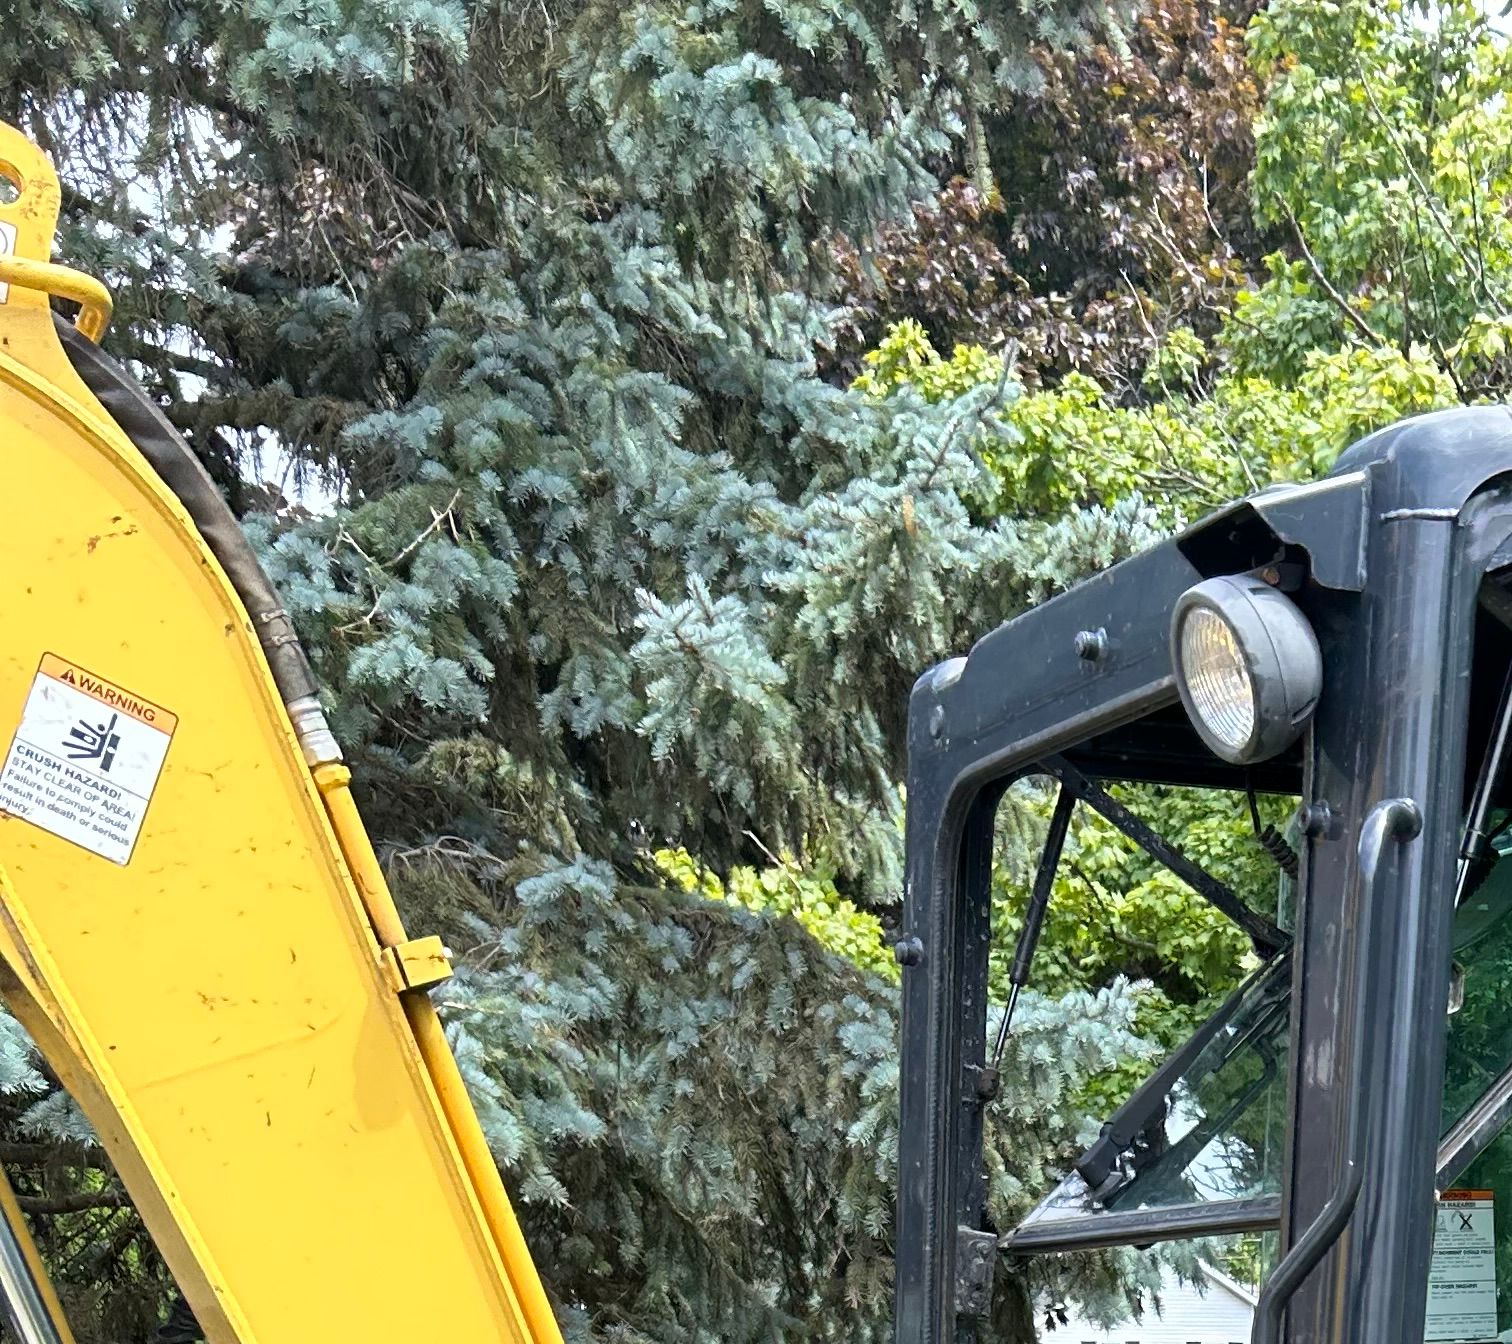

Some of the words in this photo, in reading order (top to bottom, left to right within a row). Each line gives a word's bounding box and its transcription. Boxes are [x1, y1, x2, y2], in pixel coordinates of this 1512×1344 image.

[80, 674, 156, 722] WARNING
[7, 768, 43, 791] Failure
[45, 786, 56, 798] to
[56, 794, 97, 818] comply
[98, 813, 128, 832] could
[11, 756, 42, 776] STAY
[43, 772, 82, 795] CLEAR
[83, 791, 100, 802] OF
[100, 799, 136, 823] AREA!
[16, 744, 62, 772] CRUSH
[64, 768, 122, 800] HAZARD!
[2, 782, 34, 801] result
[35, 796, 46, 808] in
[47, 802, 77, 822] death
[79, 818, 91, 827] or
[92, 824, 130, 847] serious
